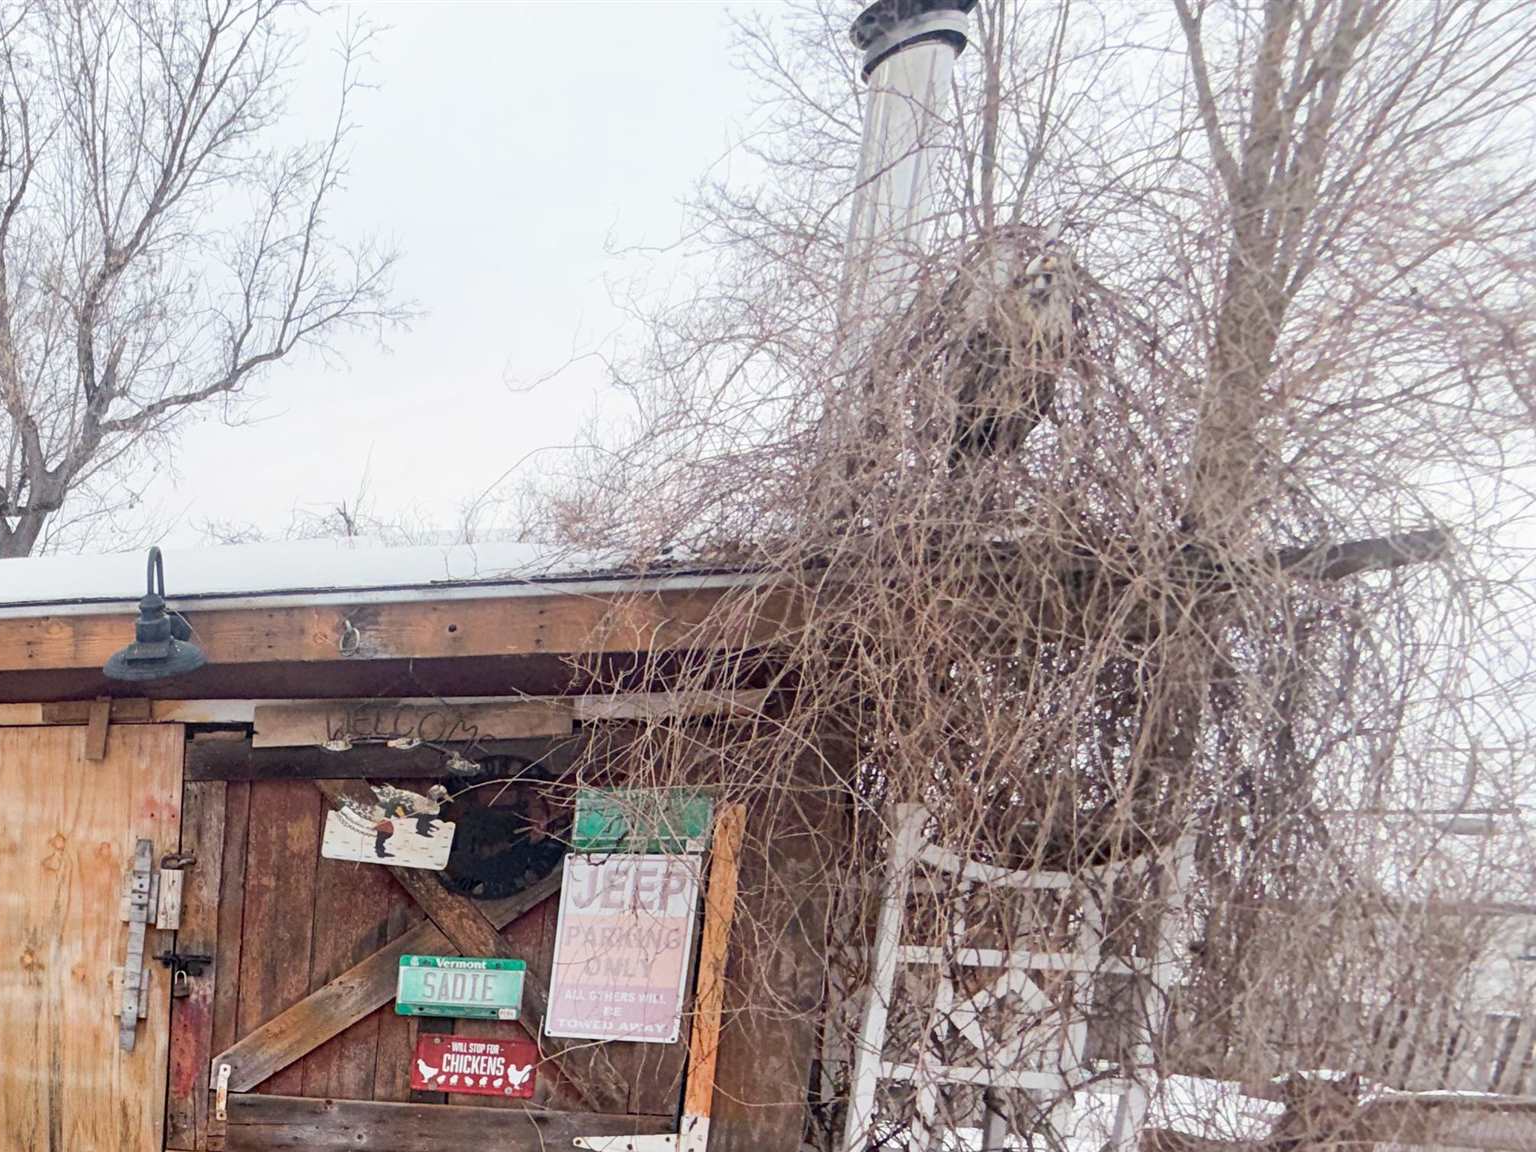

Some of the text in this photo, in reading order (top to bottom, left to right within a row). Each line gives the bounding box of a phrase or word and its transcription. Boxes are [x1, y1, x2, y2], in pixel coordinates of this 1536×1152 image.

[326, 705, 496, 752] WELCOM
[572, 866, 687, 912] JEEP
[565, 925, 680, 950] PARKING
[435, 958, 487, 969] Vermont
[584, 957, 651, 978] ONLY
[421, 971, 497, 1002] SADIE
[564, 989, 585, 1001] ALL
[451, 1042, 500, 1054] WILL STOP FOR
[442, 1053, 506, 1076] CHICKENS
